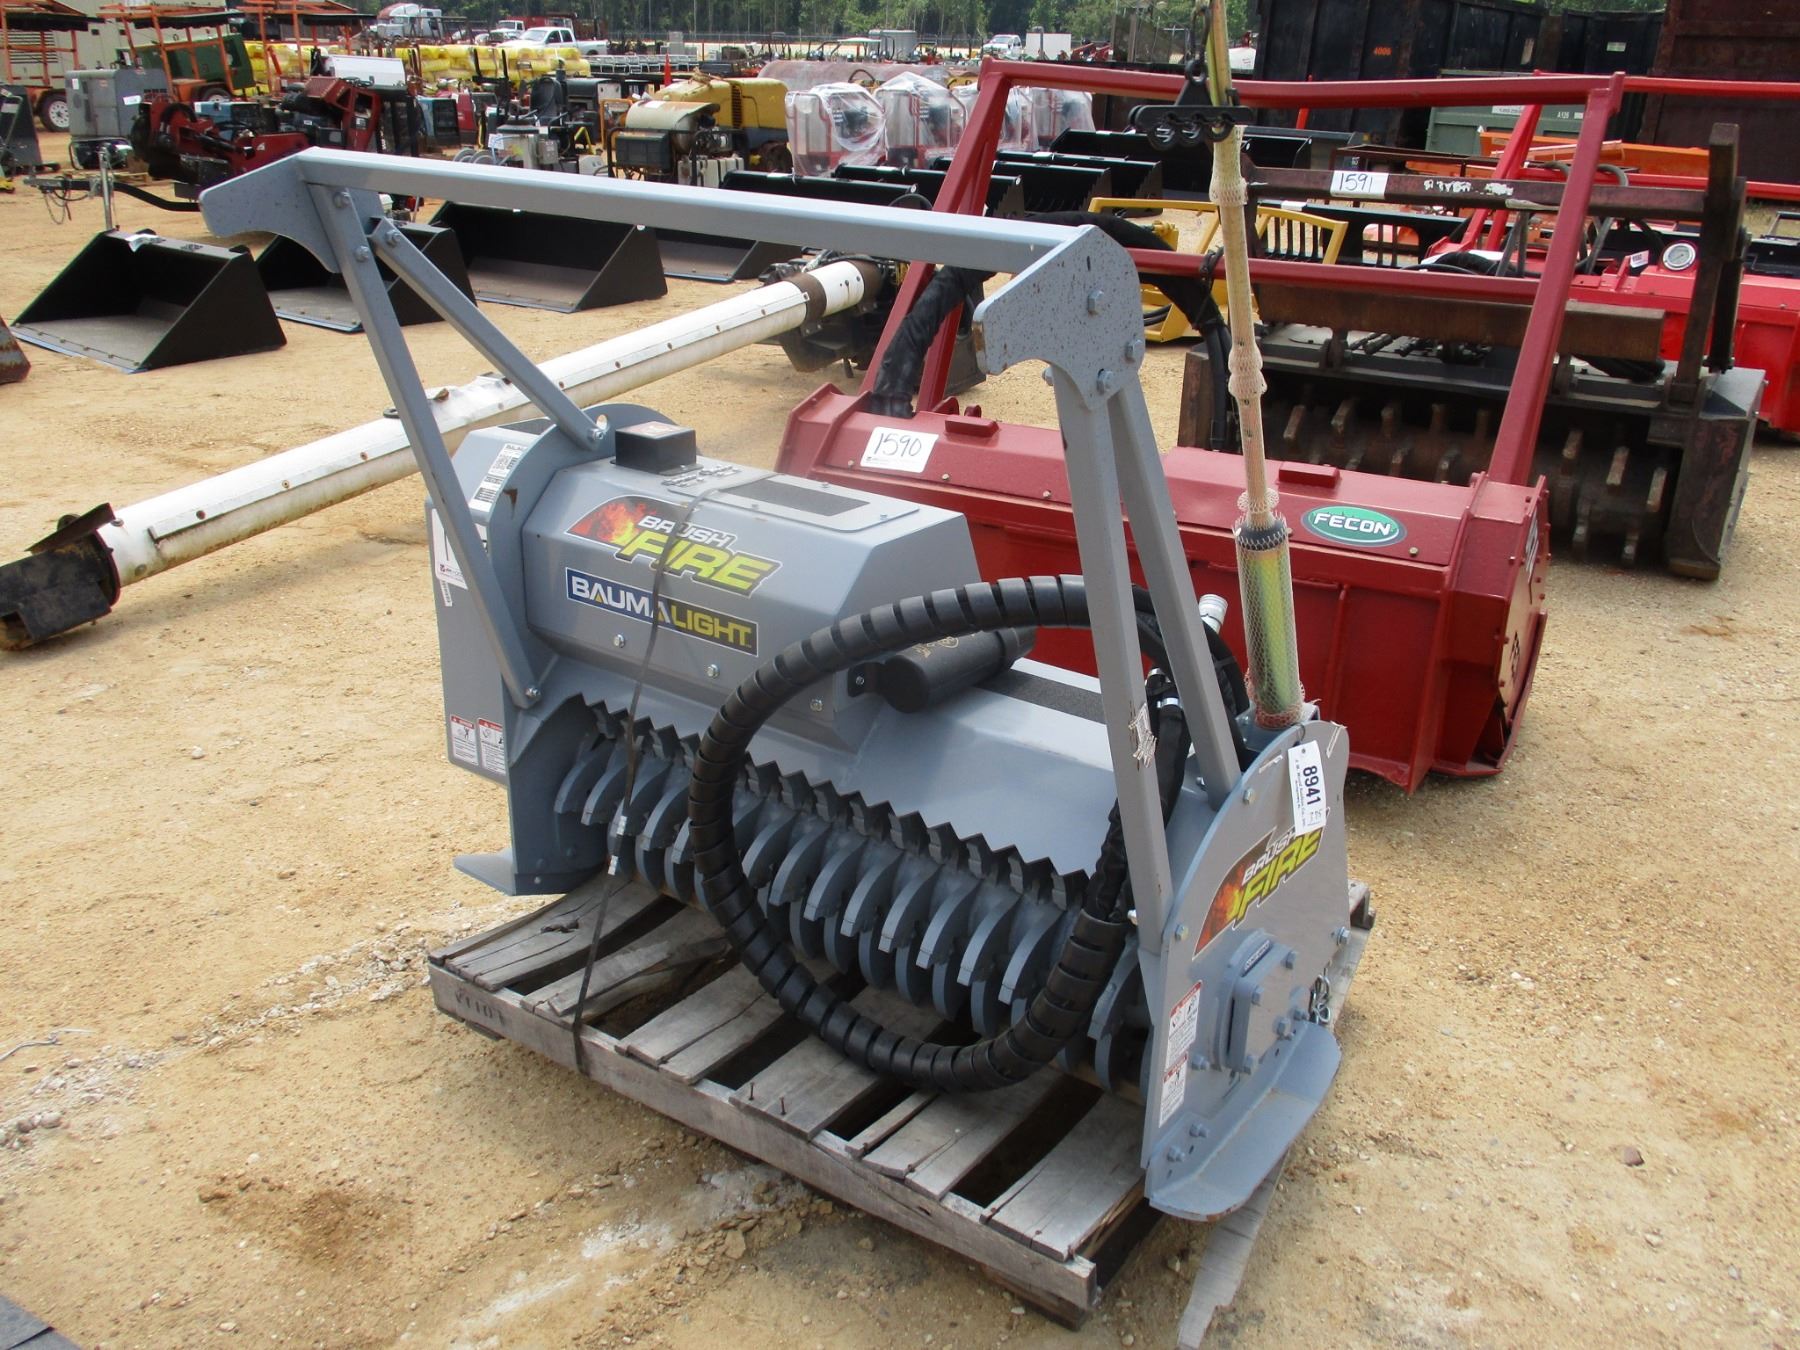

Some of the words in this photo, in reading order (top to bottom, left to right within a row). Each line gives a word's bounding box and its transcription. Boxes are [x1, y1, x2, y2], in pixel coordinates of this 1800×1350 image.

[1339, 173, 1374, 193] 1591
[873, 432, 923, 457] 1590
[637, 514, 733, 548] BRUSH
[1313, 512, 1391, 536] FECON
[619, 529, 775, 591] FIRE
[571, 575, 753, 648] BAUMALIGHT
[1303, 765, 1322, 806] 8941
[1237, 828, 1322, 921] FIRE
[1241, 828, 1297, 887] BRUSH
